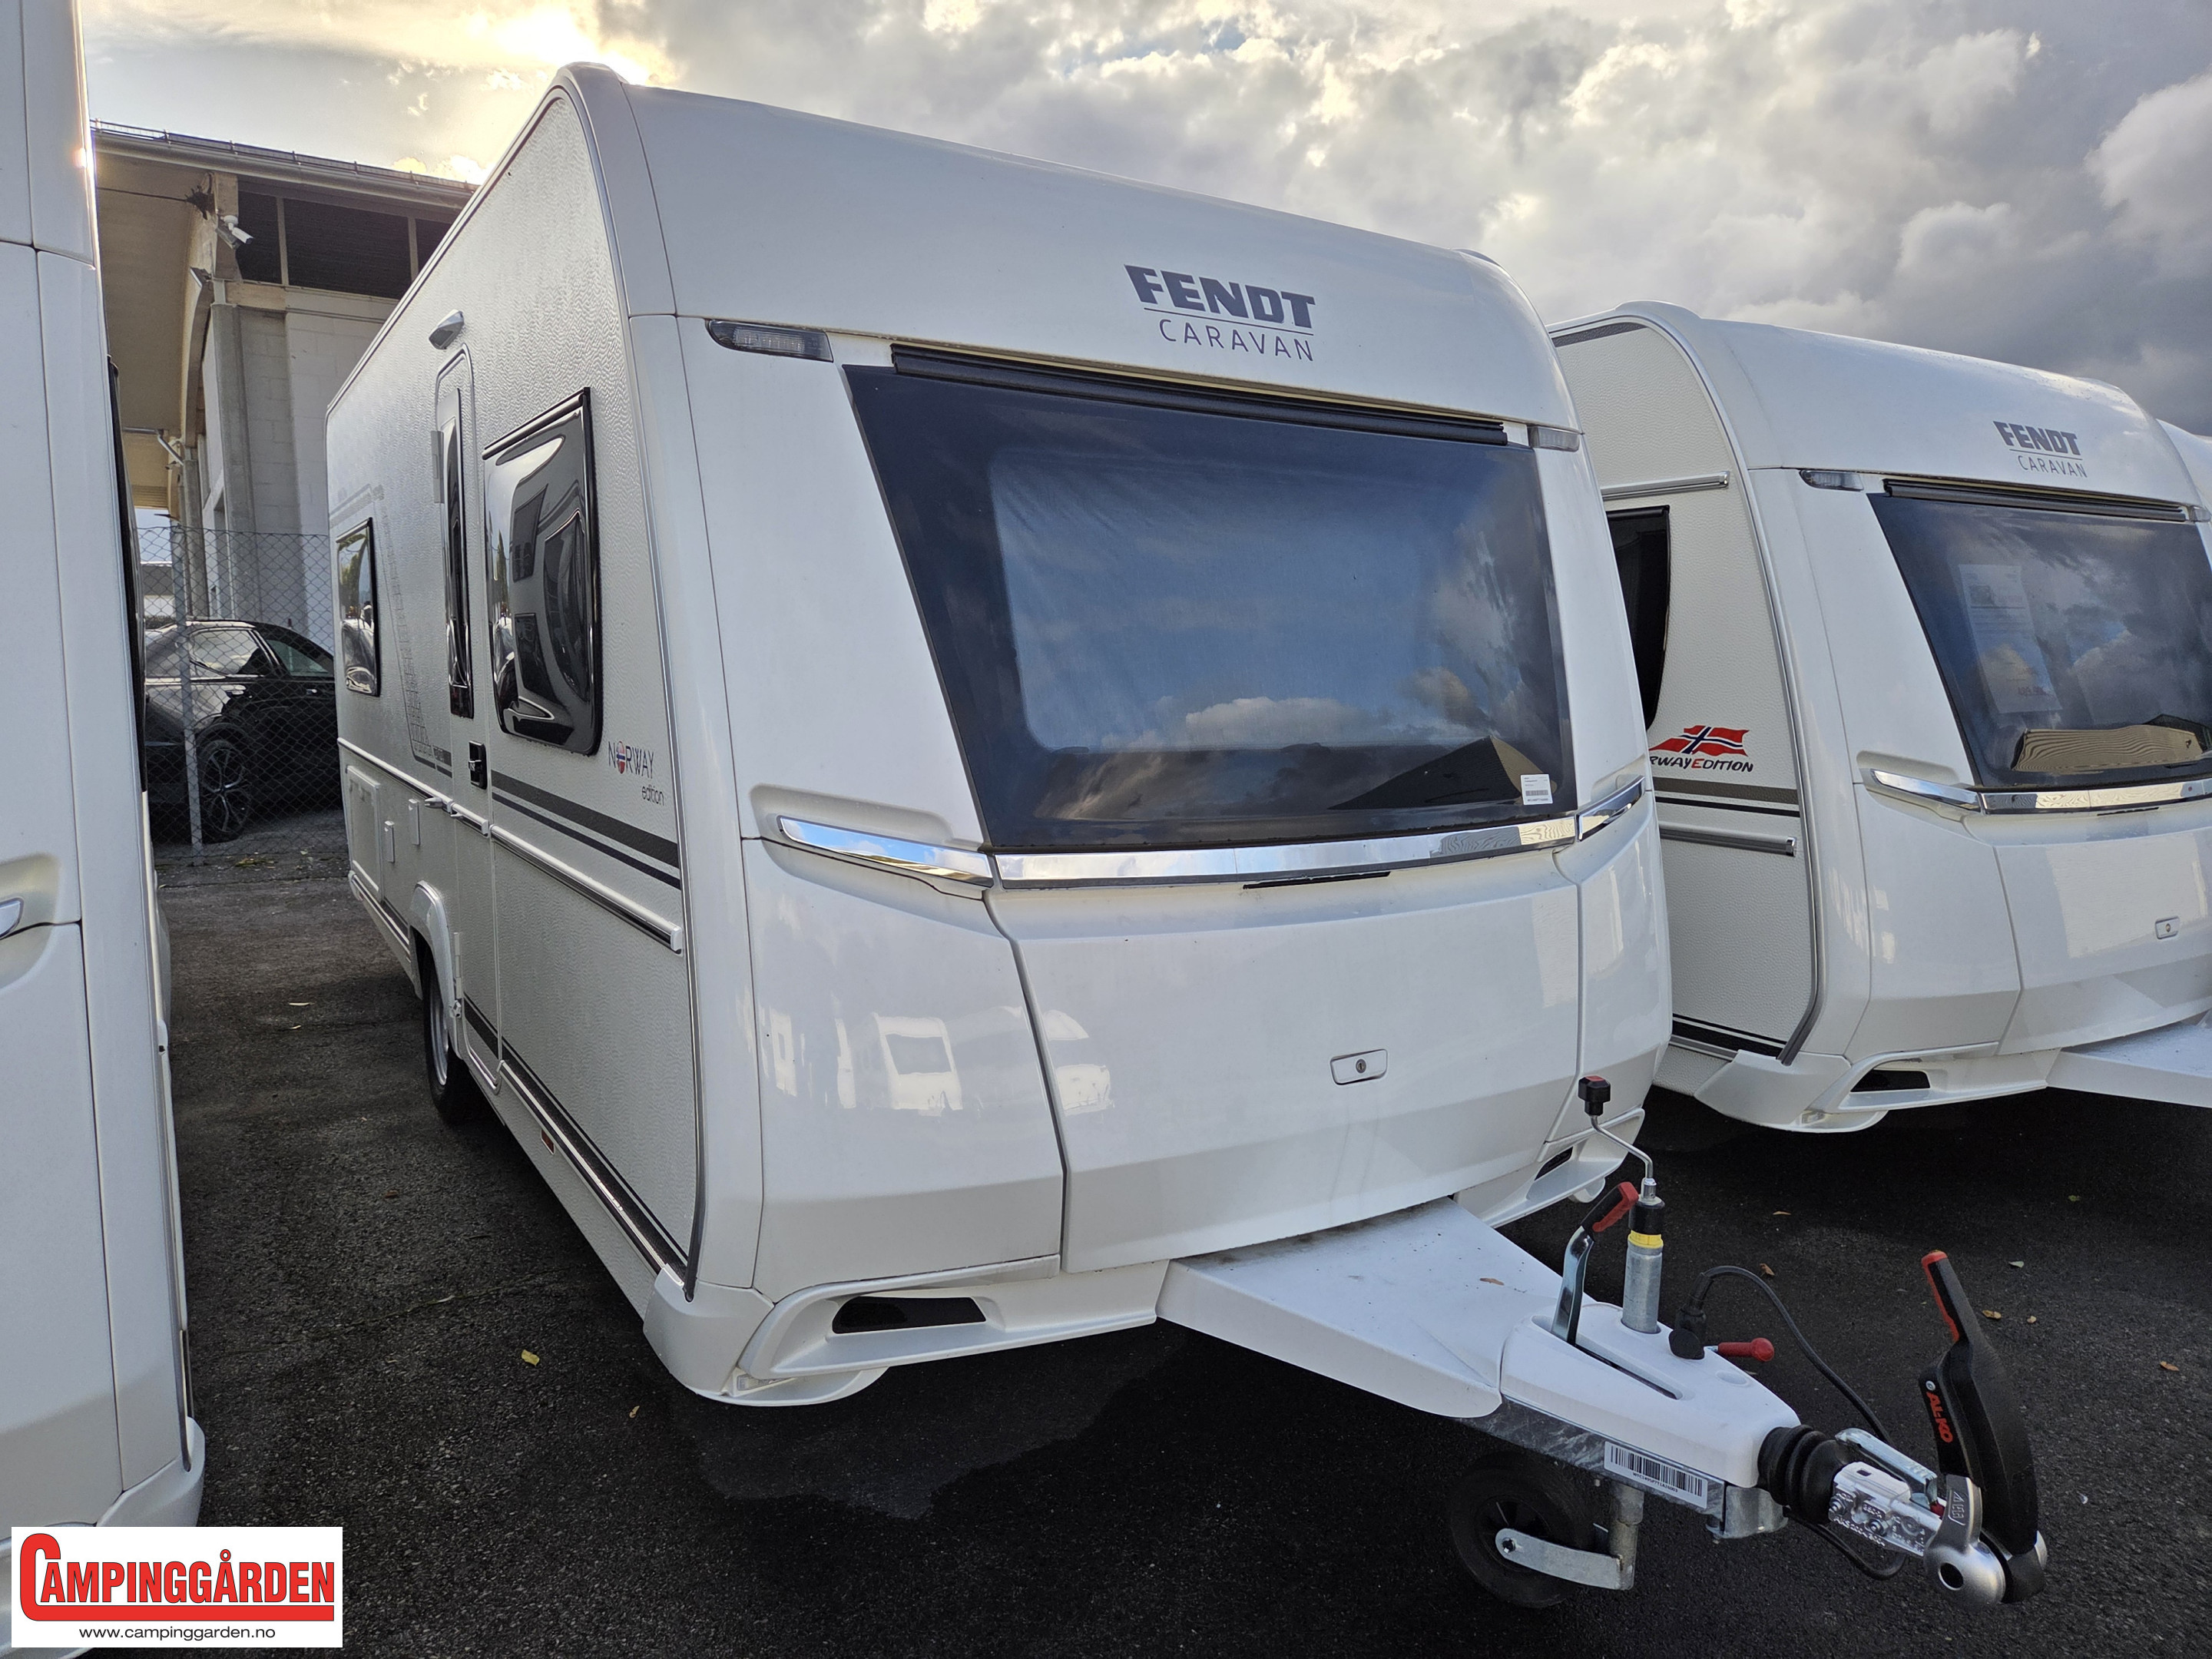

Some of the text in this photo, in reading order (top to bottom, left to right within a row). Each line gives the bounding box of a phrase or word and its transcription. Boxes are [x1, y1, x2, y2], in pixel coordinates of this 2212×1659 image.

[1124, 264, 1316, 329] FENDT
[1159, 319, 1314, 362] CARAVAN
[1992, 420, 2081, 455] FENDT
[2018, 455, 2088, 478] CARAVAN
[608, 740, 654, 779] NORWAY
[641, 784, 665, 806] edition
[1926, 1391, 1953, 1443] AL-KO
